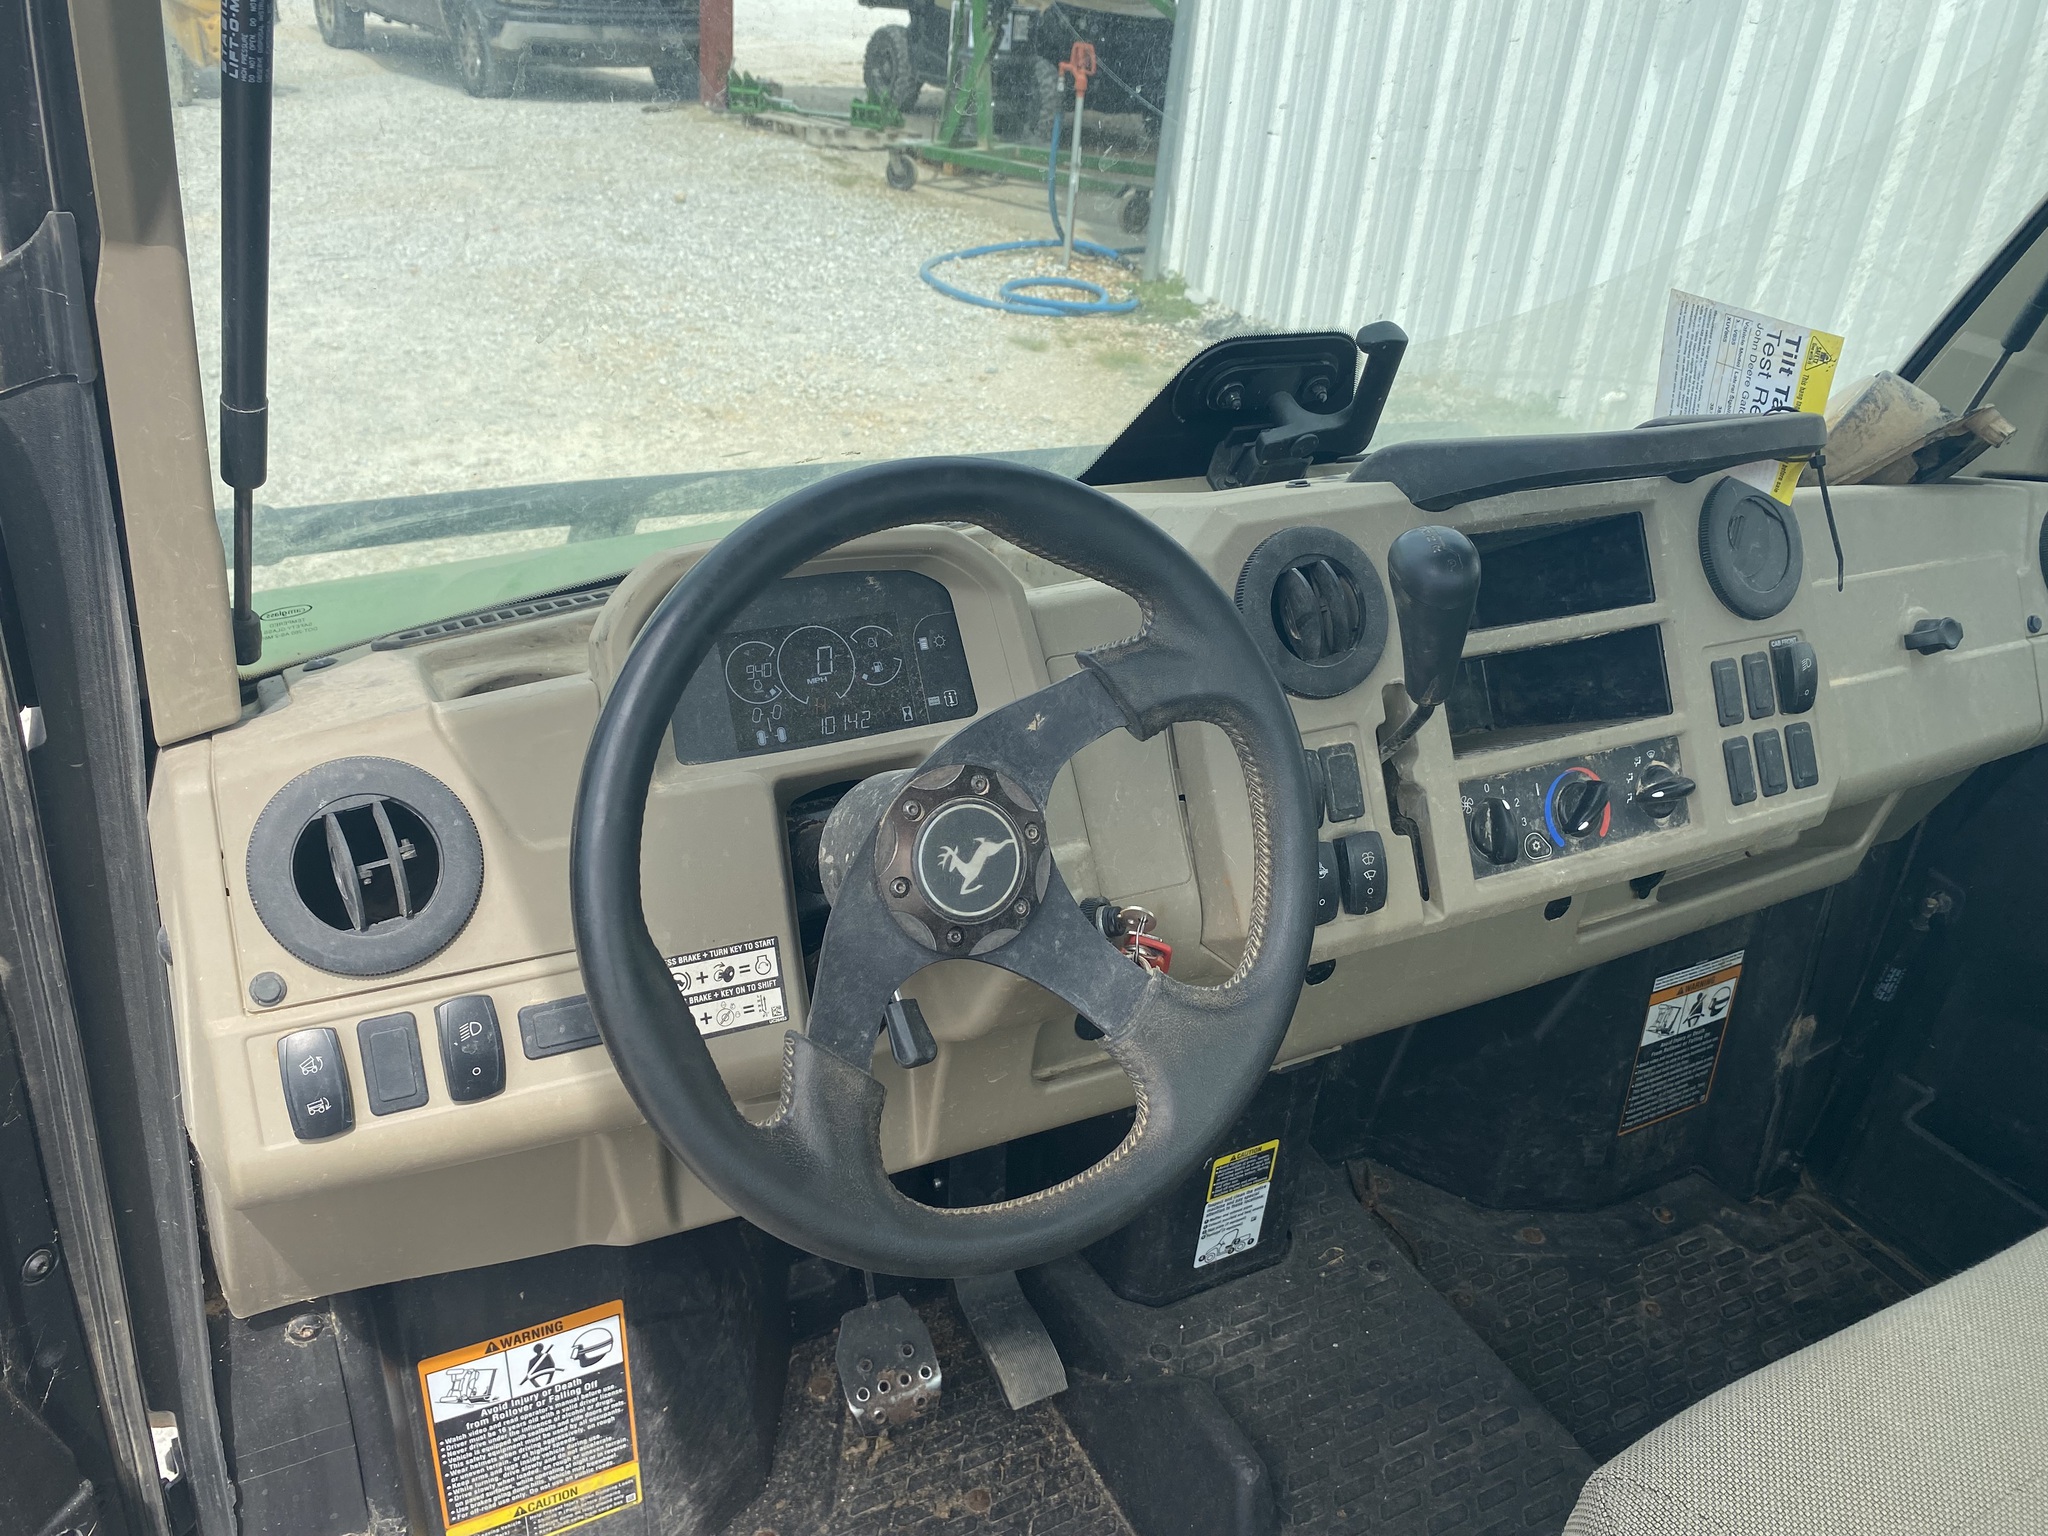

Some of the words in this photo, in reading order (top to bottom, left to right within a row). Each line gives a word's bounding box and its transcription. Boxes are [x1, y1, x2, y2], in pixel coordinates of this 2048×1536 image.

[1752, 323, 1763, 351] John
[1744, 354, 1757, 387] Deere
[1758, 330, 1782, 379] Test
[1779, 336, 1802, 376] Tilt
[1801, 374, 1809, 386] This
[1782, 637, 1797, 645] FRONT
[746, 662, 772, 680] 940
[816, 646, 833, 676] 0
[806, 676, 828, 684] MPH
[1484, 783, 1490, 793] 0
[1514, 798, 1520, 808] 2
[1522, 817, 1527, 827] 3
[678, 954, 701, 964] BRAKE
[710, 949, 728, 958] TURN
[730, 944, 742, 954] KEY
[744, 942, 754, 950] TO
[754, 938, 775, 949] START
[689, 994, 712, 1004] BRAKE
[721, 988, 734, 998] KEY
[736, 985, 746, 995] ON
[748, 984, 756, 992] TO
[757, 979, 777, 990] SHIFT
[1685, 976, 1715, 992] WARNING
[1237, 1146, 1262, 1160] CAUTION
[500, 1320, 564, 1348] WARNING
[466, 1418, 489, 1430] from
[492, 1404, 533, 1422] Rollover
[536, 1399, 546, 1407] or
[549, 1388, 581, 1403] Falling
[584, 1380, 597, 1391] Off
[481, 1402, 508, 1417] Avoid
[511, 1393, 539, 1407] Injury
[542, 1389, 552, 1397] or
[555, 1378, 582, 1392] Death
[445, 1434, 467, 1444] Watch
[468, 1427, 487, 1437] video
[503, 1416, 519, 1425] read
[554, 1395, 579, 1408] manual
[581, 1389, 602, 1399] before
[446, 1440, 467, 1451] Driver
[469, 1434, 487, 1443] must
[507, 1421, 527, 1431] years
[540, 1411, 555, 1420] with
[561, 1403, 578, 1412] valid
[579, 1397, 598, 1407] driver
[447, 1447, 468, 1457] Never
[469, 1441, 487, 1450] drive
[488, 1434, 508, 1444] under
[521, 1419, 552, 1432] influence
[561, 1406, 586, 1419] alcohol
[448, 1452, 473, 1463] Vehicle
[481, 1438, 512, 1453] equipped
[512, 1434, 527, 1442] with
[527, 1424, 556, 1437] seatbelts
[570, 1415, 584, 1423] side
[584, 1408, 602, 1418] doors
[448, 1462, 464, 1470] This
[465, 1454, 486, 1465] safety
[487, 1441, 523, 1457] equipment
[524, 1435, 541, 1445] must
[552, 1425, 569, 1435] used
[450, 1467, 468, 1476] Wear
[470, 1457, 497, 1470] helmets
[498, 1451, 517, 1460] when
[518, 1442, 541, 1454] driving
[596, 1416, 615, 1426] rough
[452, 1479, 470, 1489] Keep
[471, 1473, 488, 1482] arms
[504, 1463, 519, 1471] legs
[520, 1454, 540, 1466] inside
[541, 1447, 565, 1458] vehicle
[566, 1439, 588, 1450] during
[453, 1485, 473, 1495] While
[503, 1469, 520, 1478] drive
[521, 1461, 543, 1472] slowly
[454, 1492, 472, 1501] Drive
[473, 1484, 496, 1495] slowly
[497, 1477, 515, 1486] when
[552, 1456, 572, 1467] rough
[581, 1446, 604, 1457] uneven
[460, 1468, 485, 1479] uneven
[529, 1444, 551, 1456] higher
[465, 1493, 485, 1505] paved
[516, 1477, 534, 1486] while
[535, 1466, 564, 1480] operating
[572, 1457, 588, 1466] night
[470, 1498, 492, 1509] brakes
[493, 1491, 512, 1501] going
[512, 1485, 530, 1494] down
[548, 1470, 571, 1481] Vehicle
[470, 1501, 497, 1515] off-road
[574, 1468, 594, 1479] public
[527, 1486, 578, 1513] CAUTION
